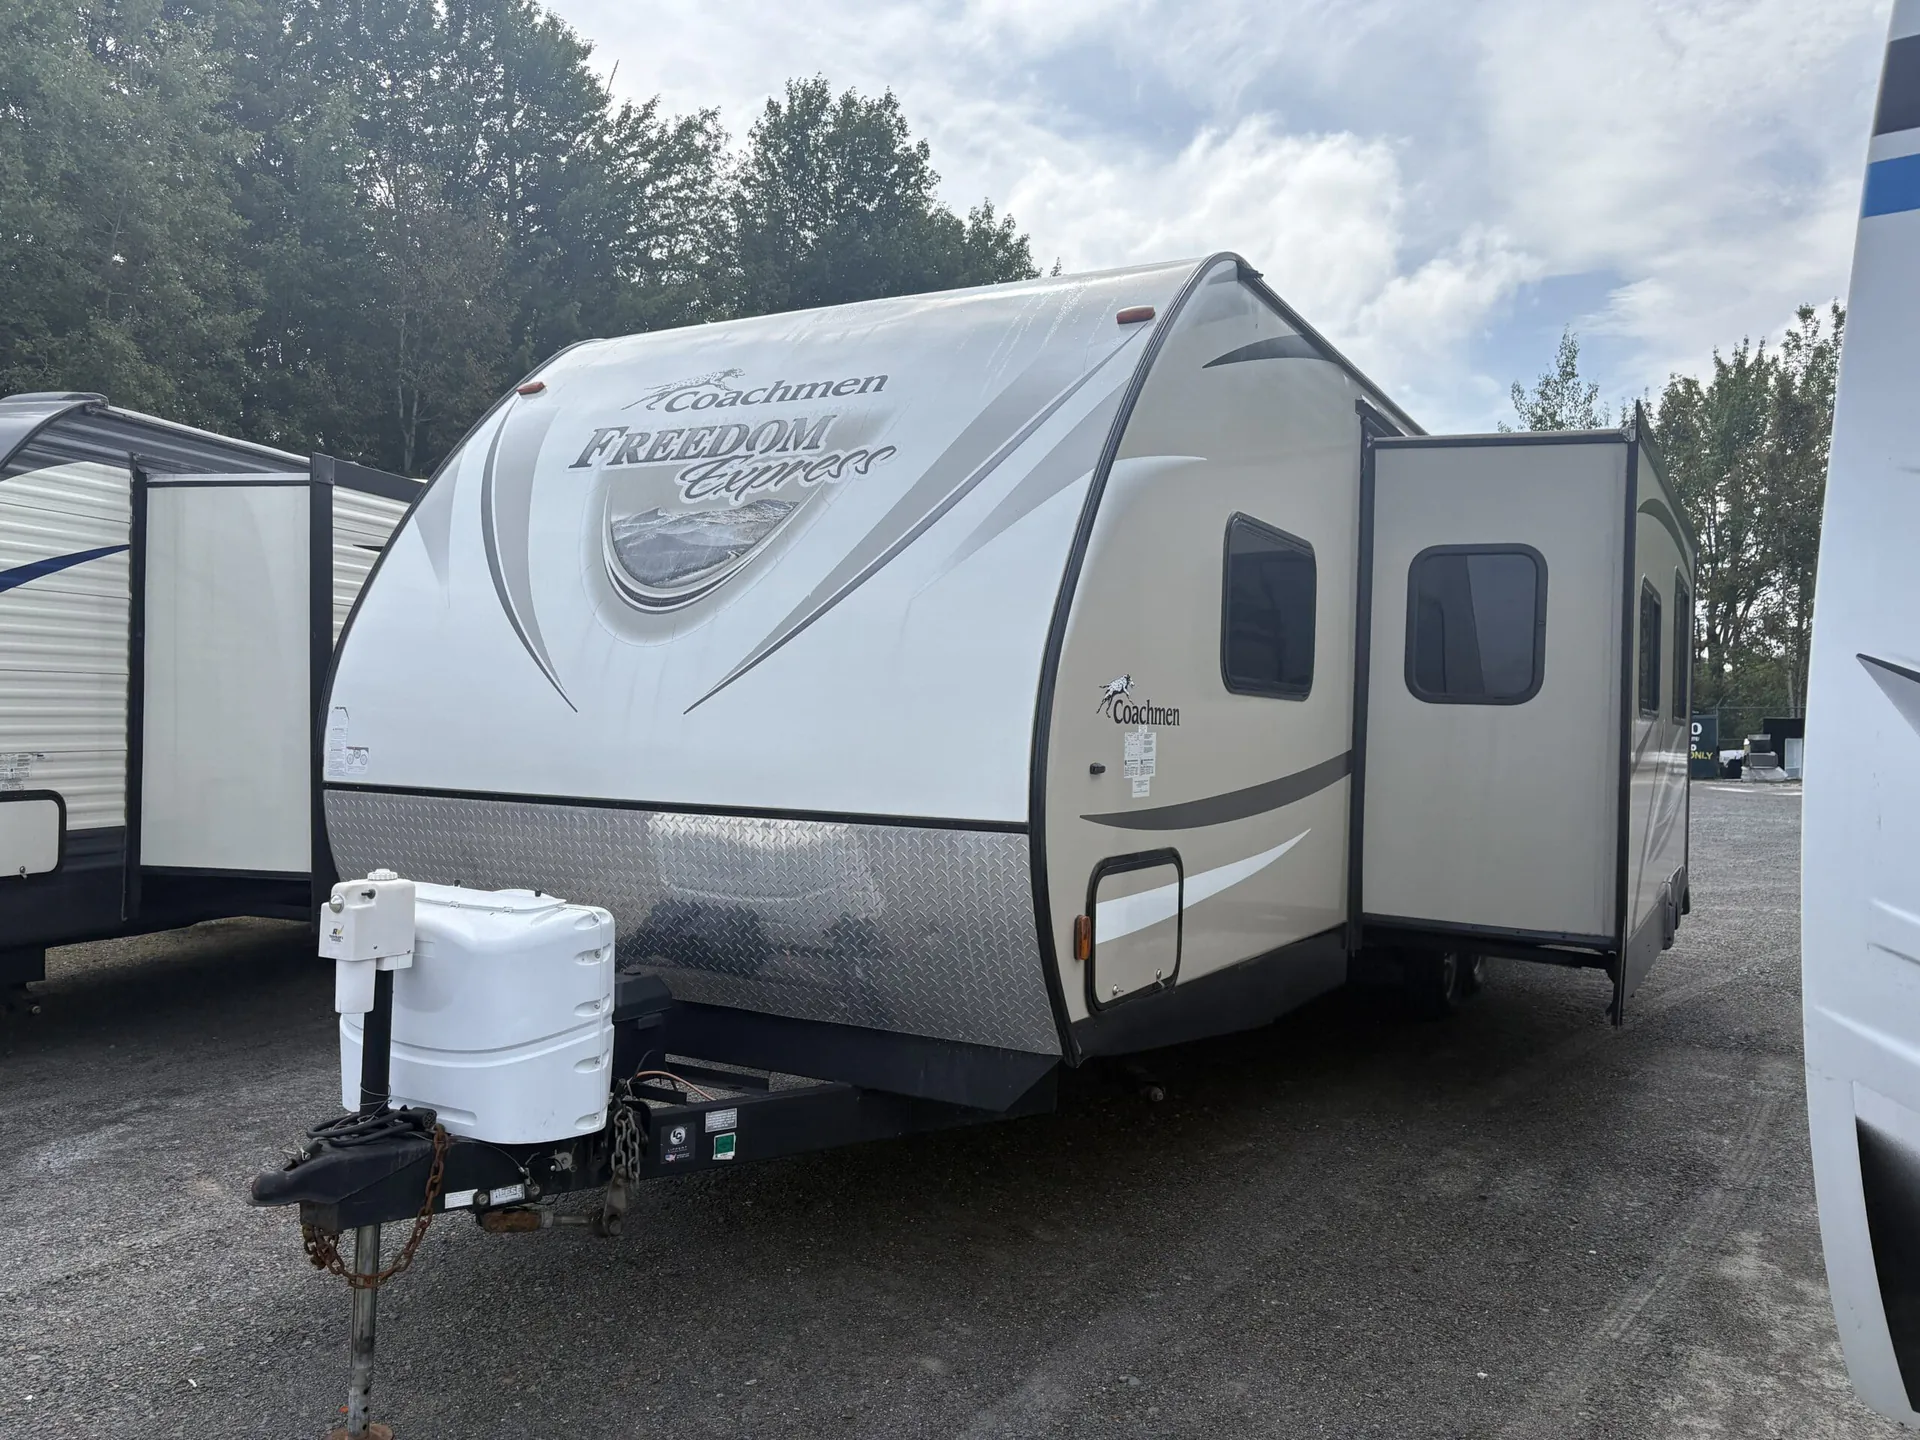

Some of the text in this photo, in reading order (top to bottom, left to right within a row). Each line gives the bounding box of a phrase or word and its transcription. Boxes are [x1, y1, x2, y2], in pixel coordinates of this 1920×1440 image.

[664, 374, 889, 413] Coachmen
[568, 415, 837, 469] FREEDOM
[679, 445, 897, 501] Express
[1113, 699, 1180, 726] Coachmen
